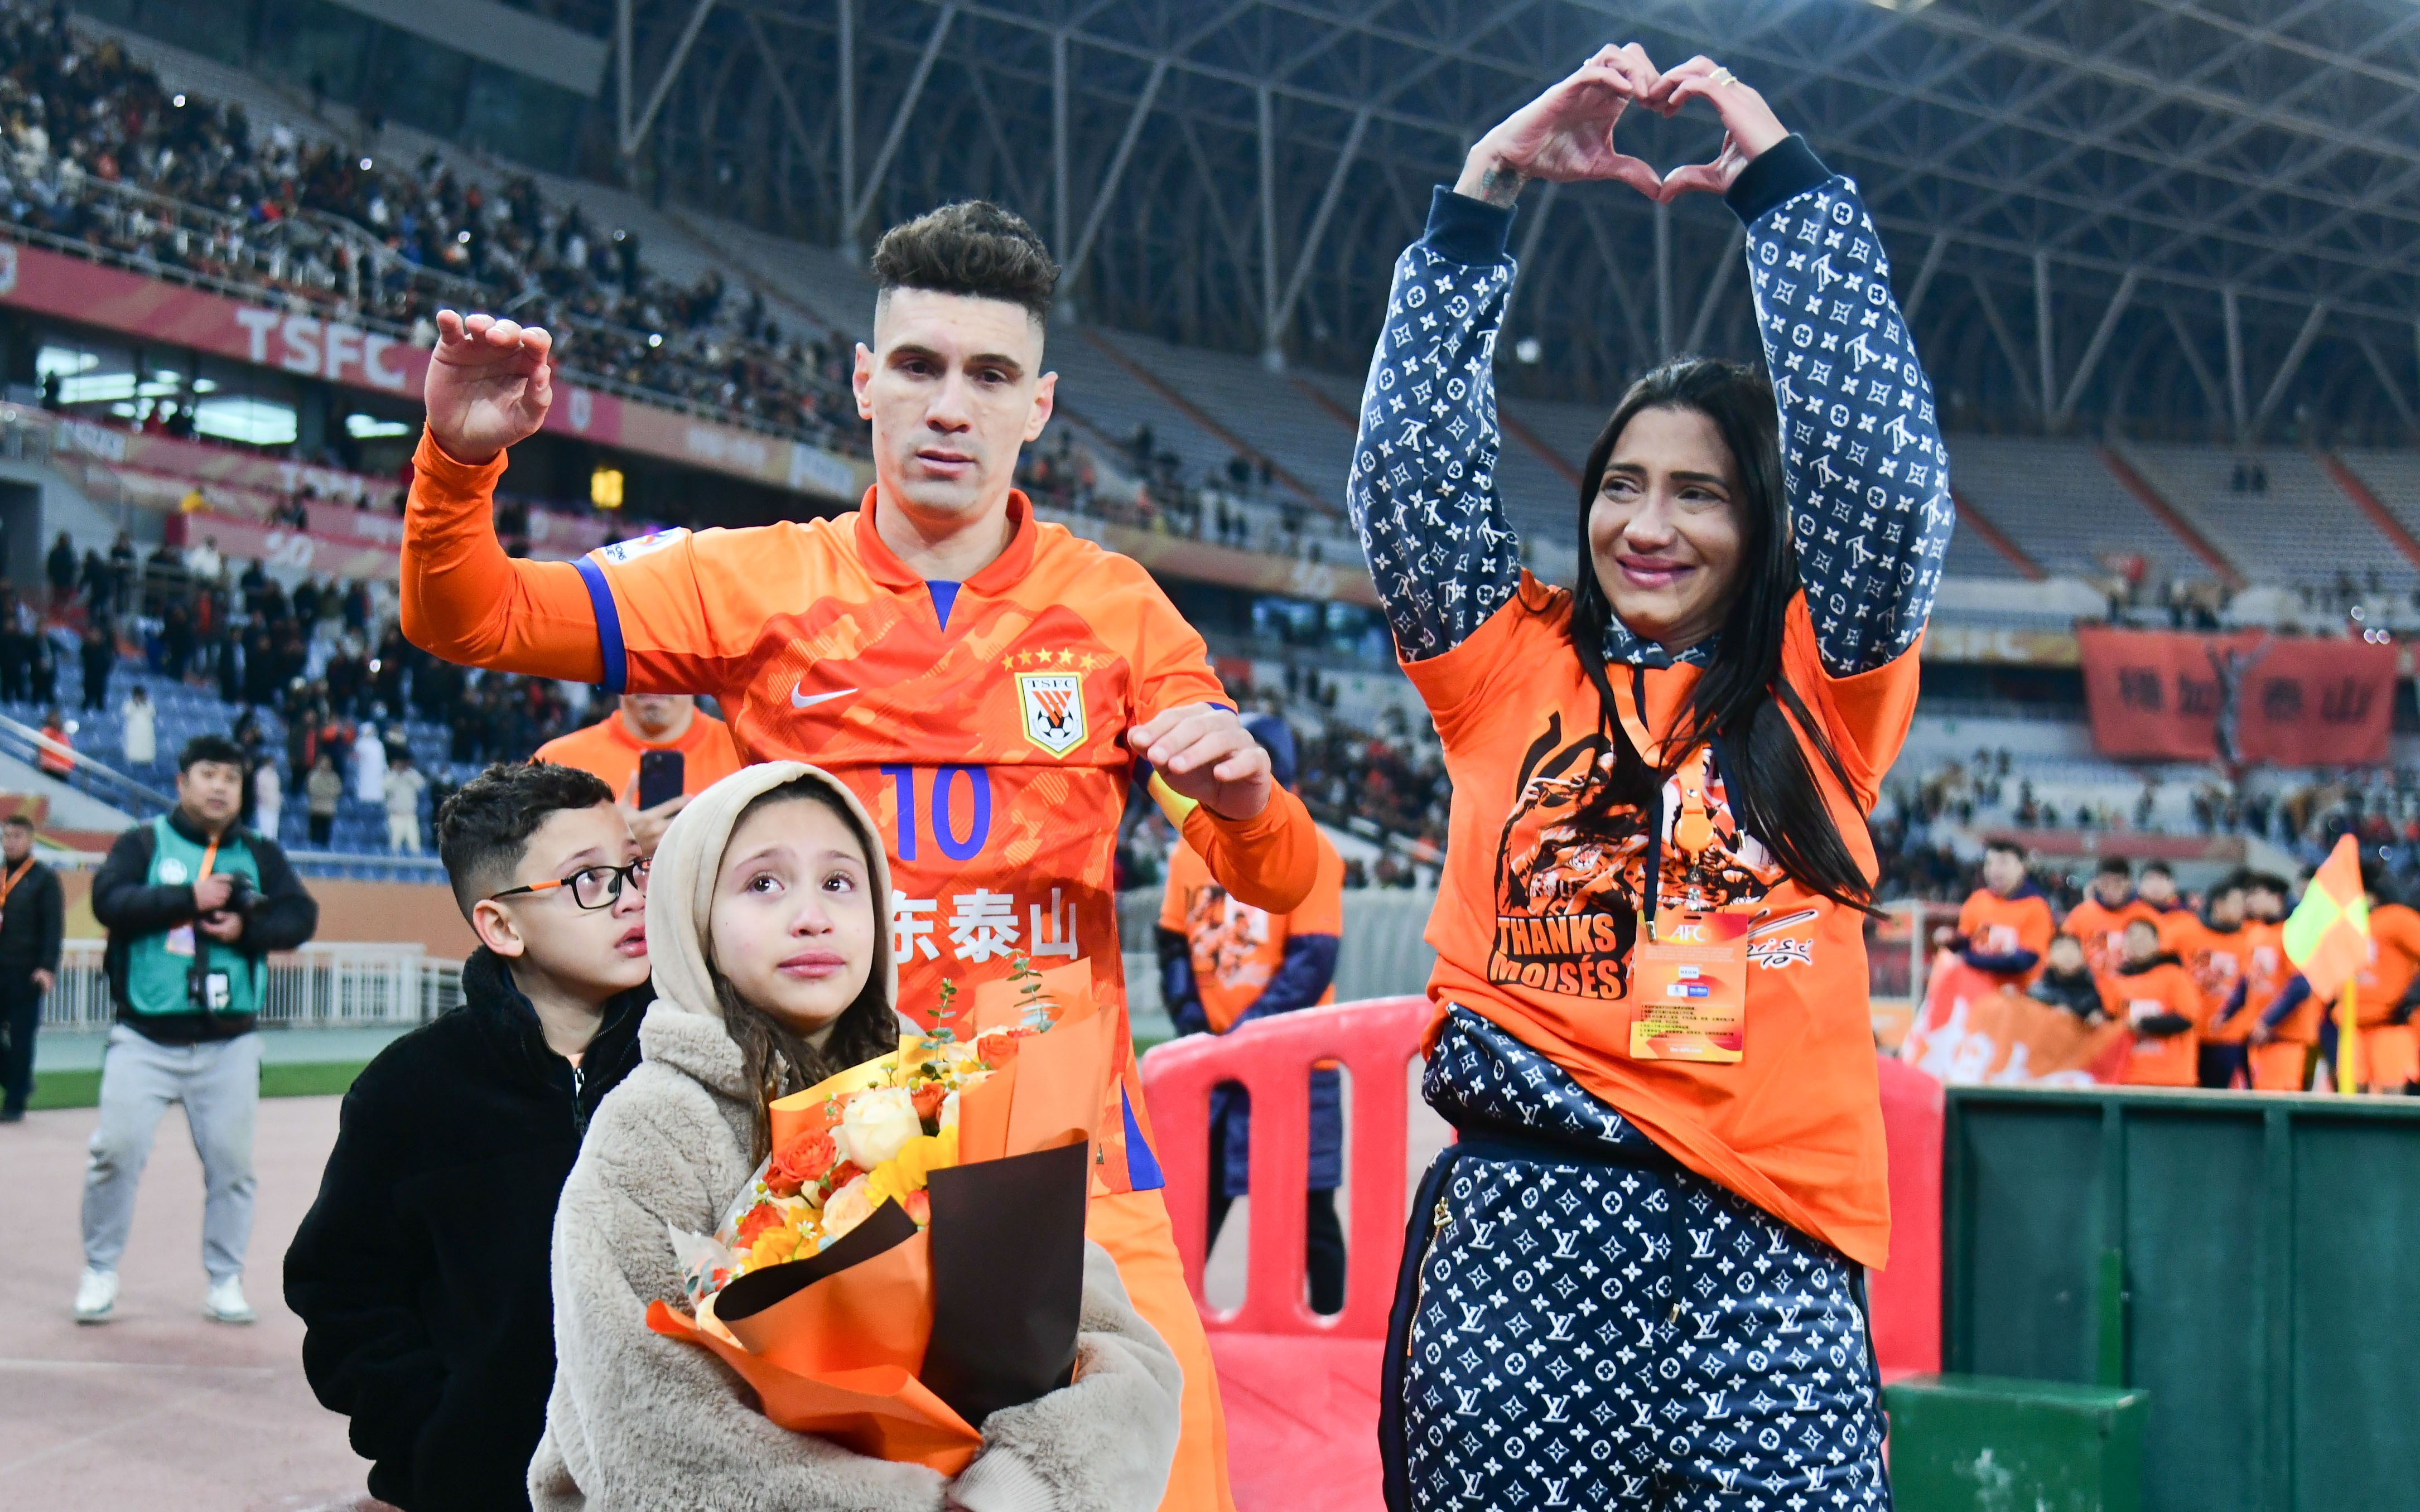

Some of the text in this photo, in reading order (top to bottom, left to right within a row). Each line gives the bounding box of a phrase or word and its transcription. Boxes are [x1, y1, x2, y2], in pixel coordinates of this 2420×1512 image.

[237, 308, 406, 389] TSFC
[1028, 679, 1073, 688] TSFC
[880, 763, 991, 861] 10
[1497, 912, 1617, 955] THANKS
[1669, 924, 1706, 942] AFC
[1489, 950, 1622, 999] MOISÉS
